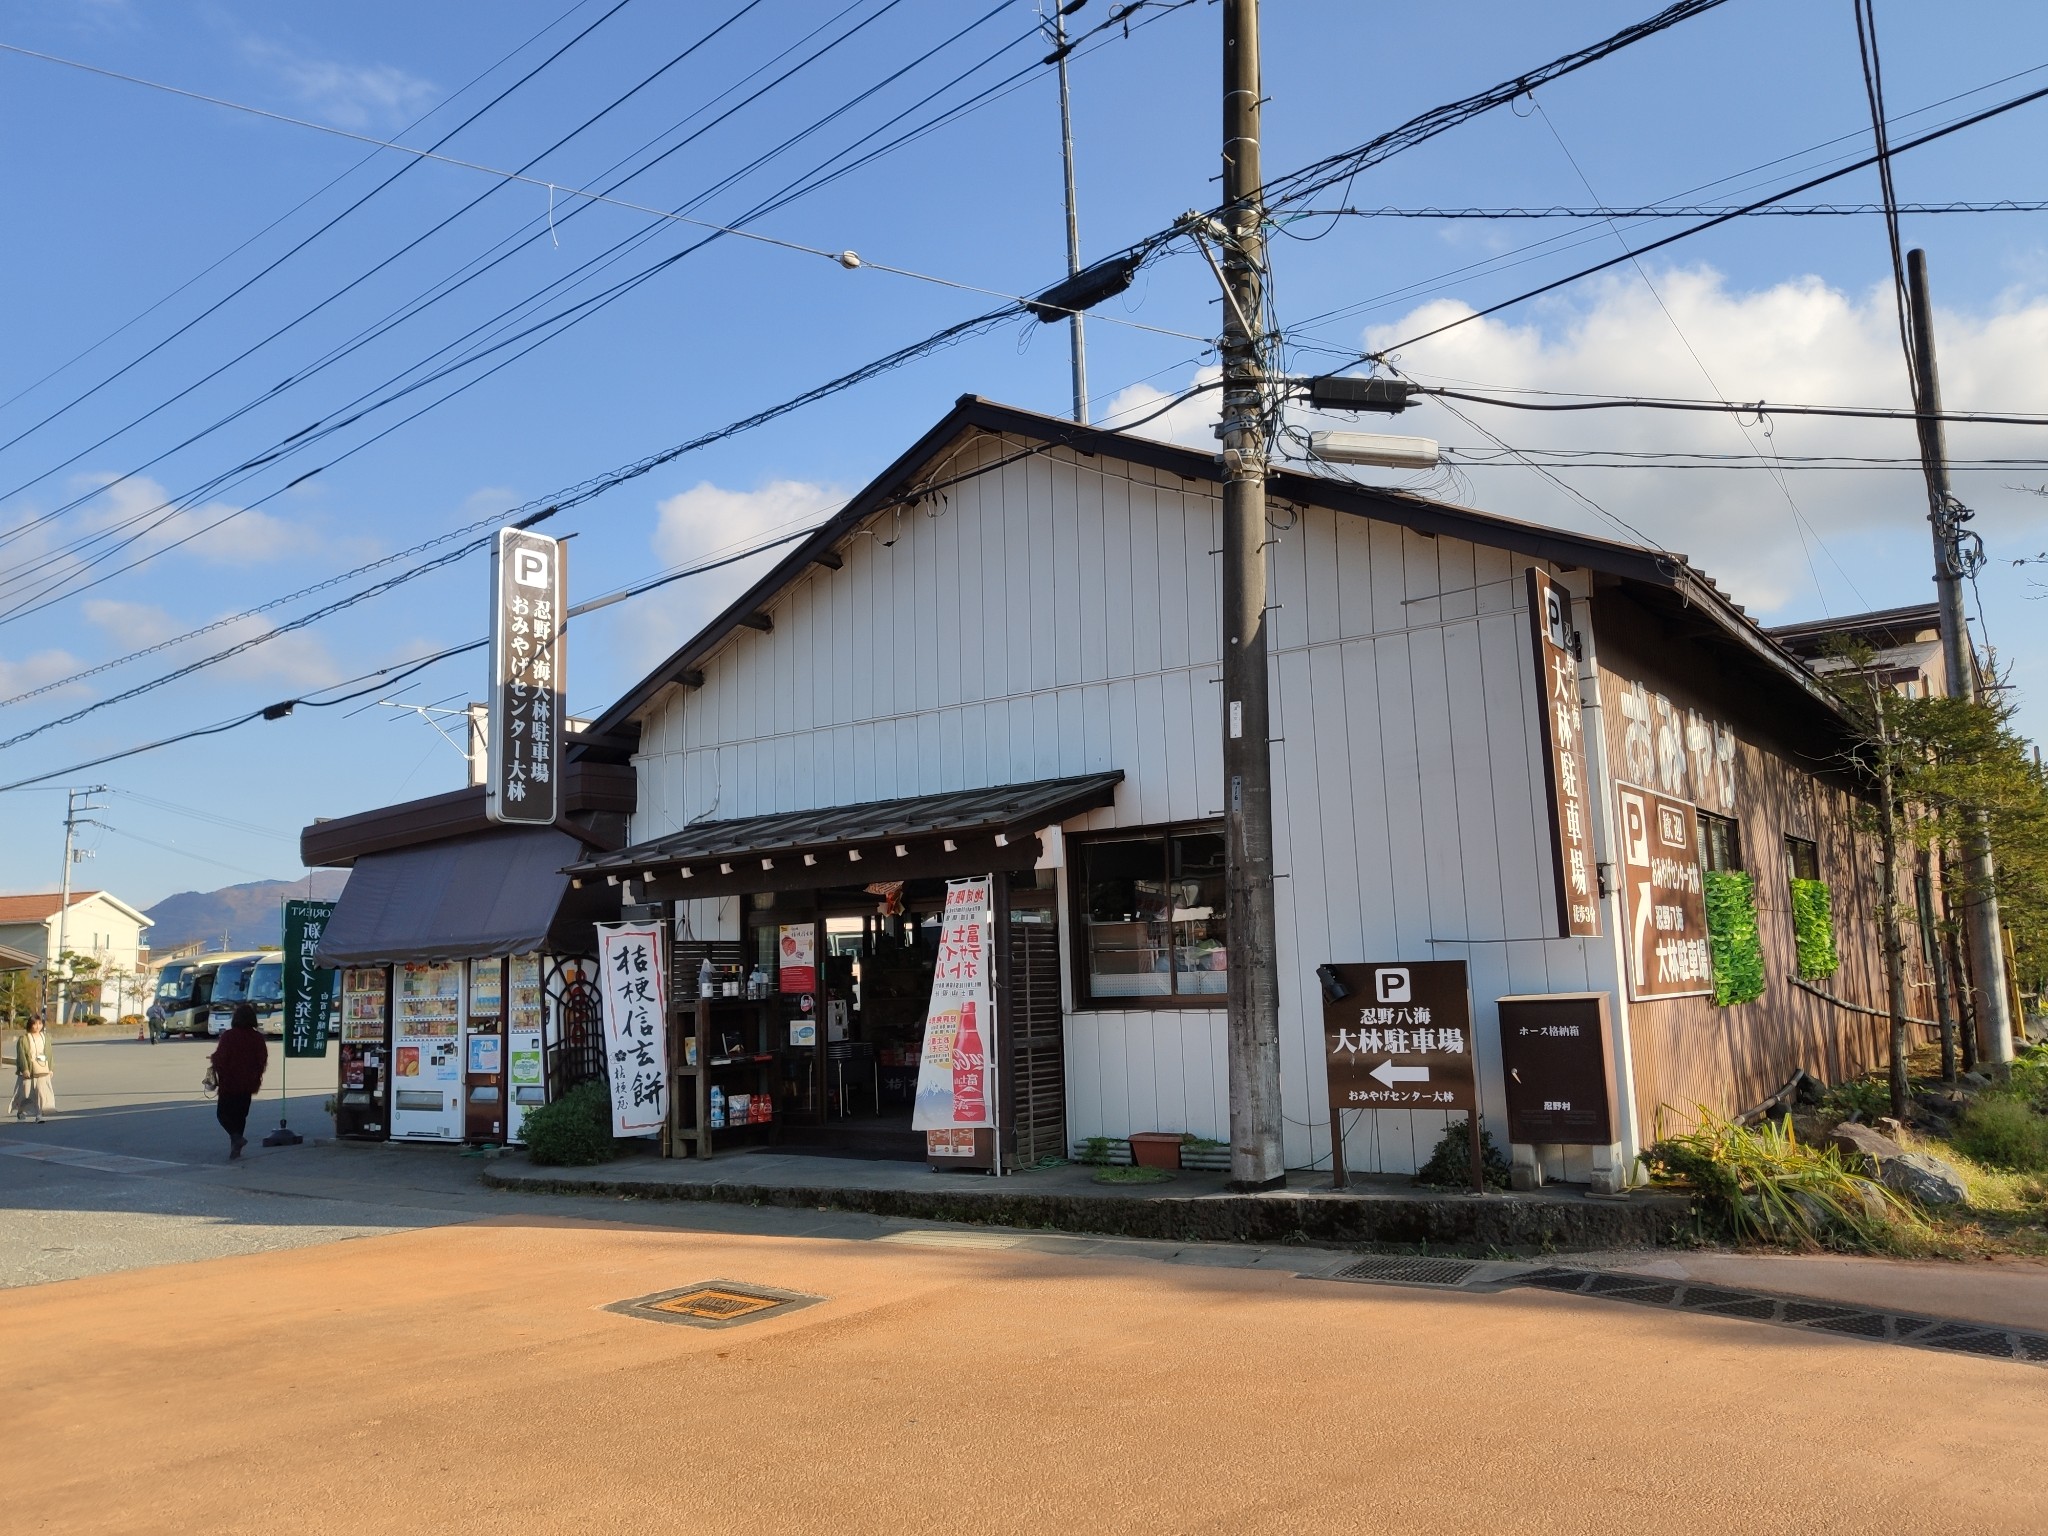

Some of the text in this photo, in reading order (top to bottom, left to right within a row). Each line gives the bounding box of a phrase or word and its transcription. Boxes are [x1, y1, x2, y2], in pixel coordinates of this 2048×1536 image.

[521, 554, 543, 581] P
[1547, 597, 1560, 638] P
[1563, 621, 1581, 732] 忍野八海
[507, 594, 530, 802] おみやげセンター大林
[1551, 654, 1587, 896] 大林駐車場
[1626, 801, 1645, 859] P
[1651, 855, 1700, 894] おみやげセンター大林
[1654, 905, 1685, 932] 忍野八海
[1655, 938, 1709, 984] 大林駐車場
[1381, 974, 1405, 999] P
[612, 944, 665, 1116] 桔梗信玄餅
[1360, 1006, 1432, 1025] 忍野八海
[1519, 1025, 1580, 1037] ホース格納箱
[1331, 1027, 1465, 1055] 大林駐車場
[1348, 1090, 1455, 1103] おみやげセンター大林
[1543, 1101, 1571, 1111] 忍野村
